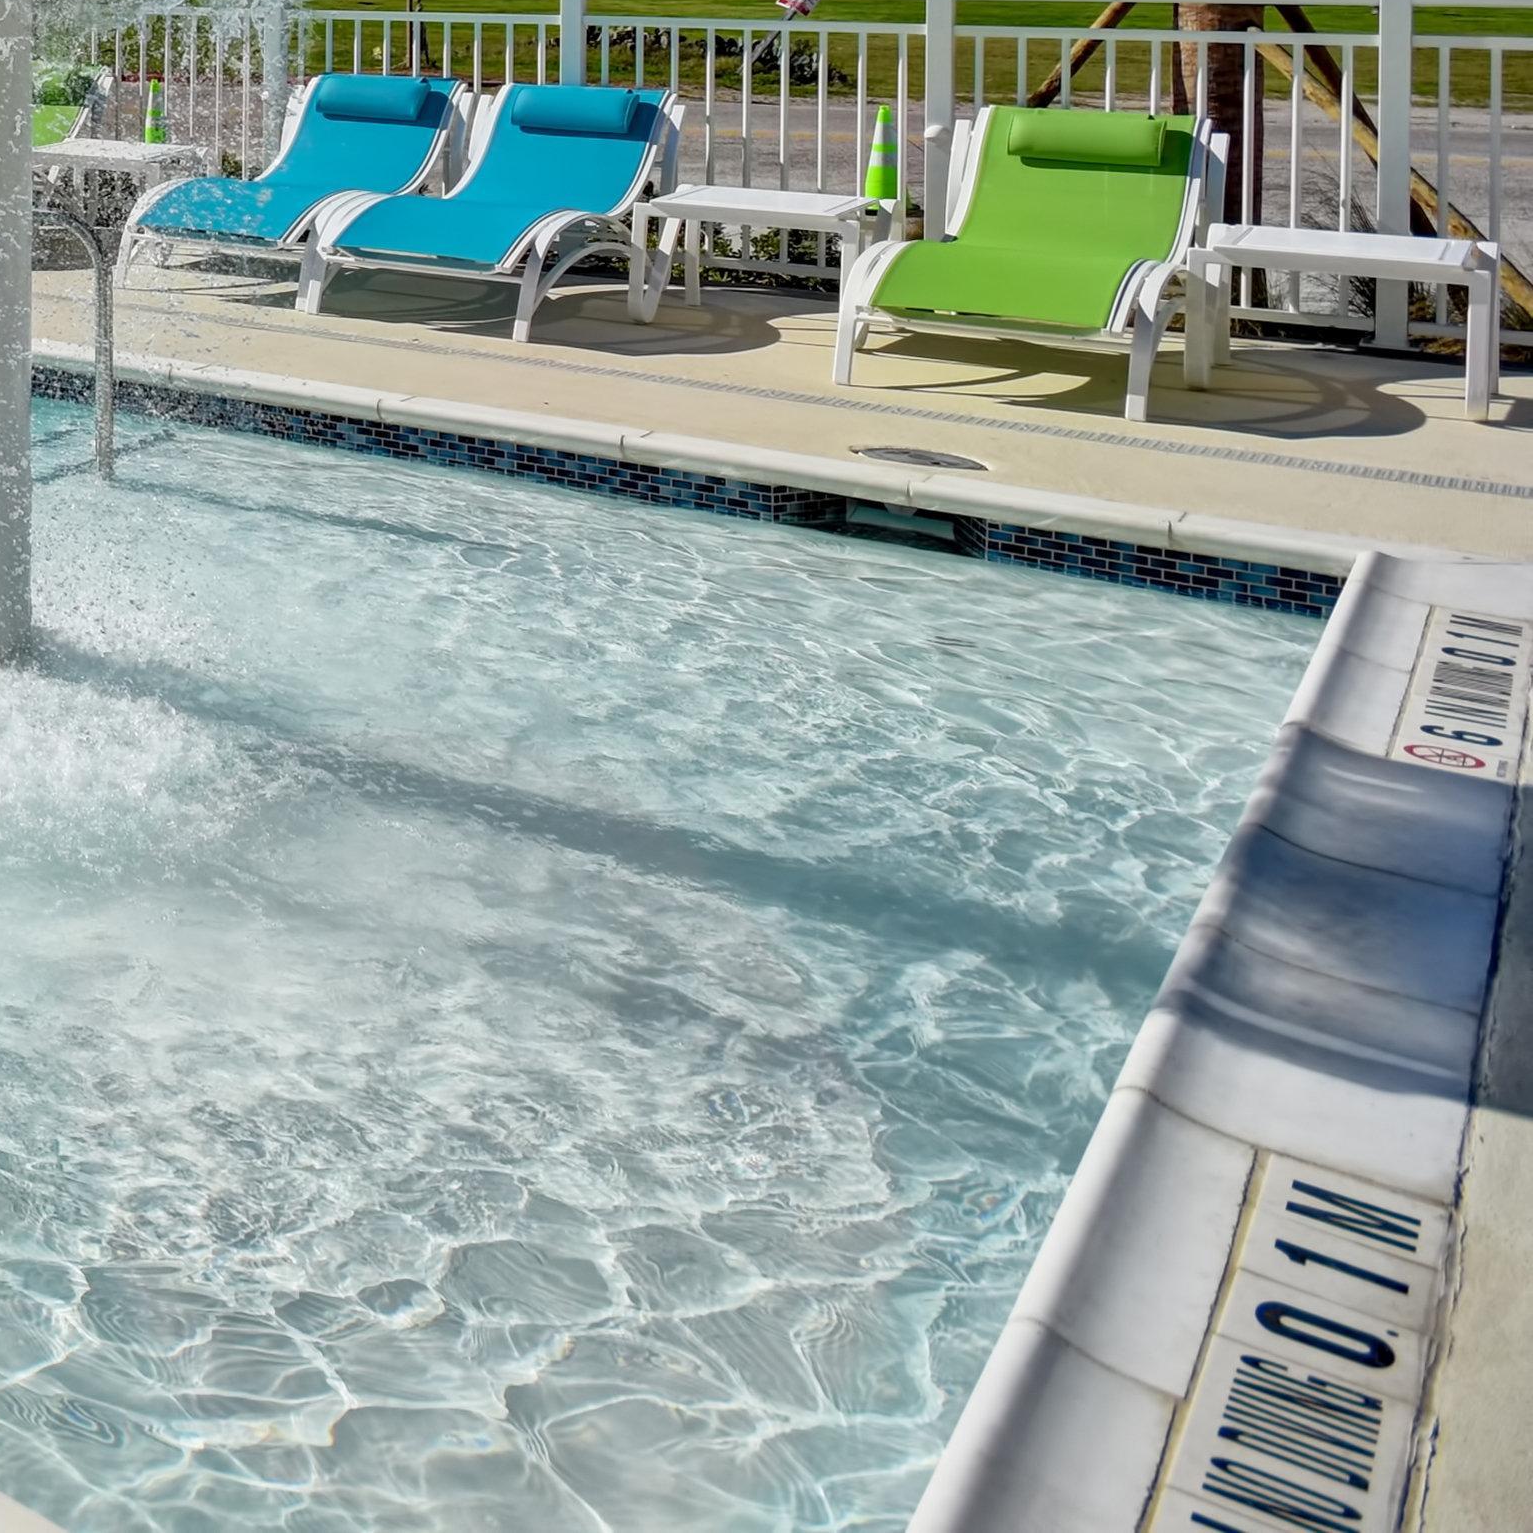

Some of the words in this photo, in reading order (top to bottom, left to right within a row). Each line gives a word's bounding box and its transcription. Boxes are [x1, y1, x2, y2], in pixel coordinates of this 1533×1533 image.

[1449, 614, 1523, 636] M
[1425, 699, 1508, 728] IN
[1420, 724, 1503, 746] 6
[1285, 1179, 1422, 1252] M
[1217, 1355, 1383, 1493] DIVING
